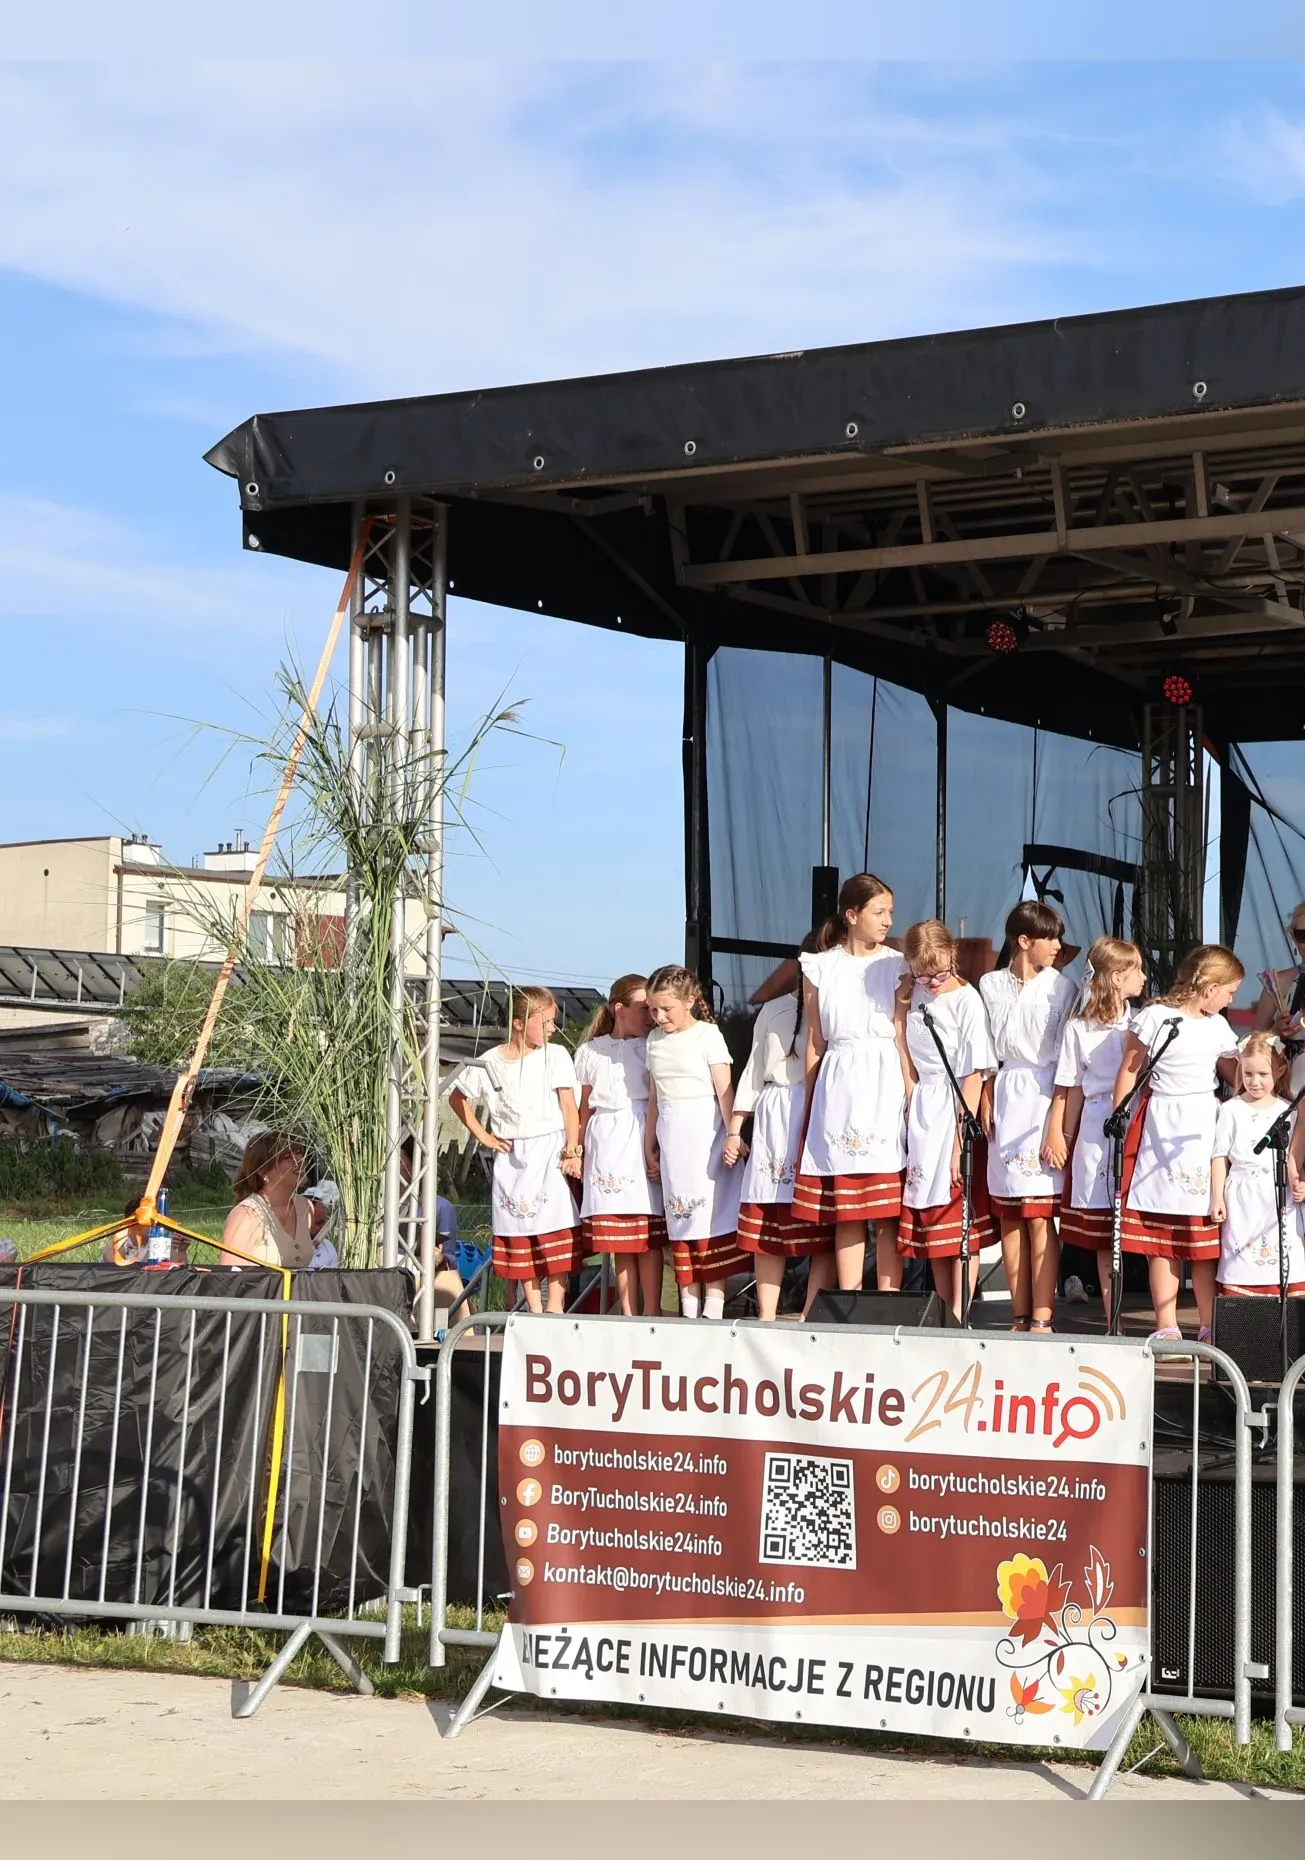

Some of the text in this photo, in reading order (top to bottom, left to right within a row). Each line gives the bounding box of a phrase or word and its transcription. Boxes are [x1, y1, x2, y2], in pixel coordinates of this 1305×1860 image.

[525, 1354, 1101, 1448] BoryTucholskie24.info
[553, 1444, 728, 1476] borytucholskie24.info
[550, 1484, 728, 1518] BoryTucholskie24.info
[909, 1468, 1107, 1501] borytucholskie24.info
[546, 1523, 723, 1556] Borytucholskie24info
[909, 1510, 1068, 1542] borytucholskie24
[543, 1562, 805, 1604] kontakt@borytucholskie24.info
[639, 1641, 827, 1695] INFORMACJE
[836, 1661, 855, 1698] Z
[863, 1664, 997, 1714] REGIONU
